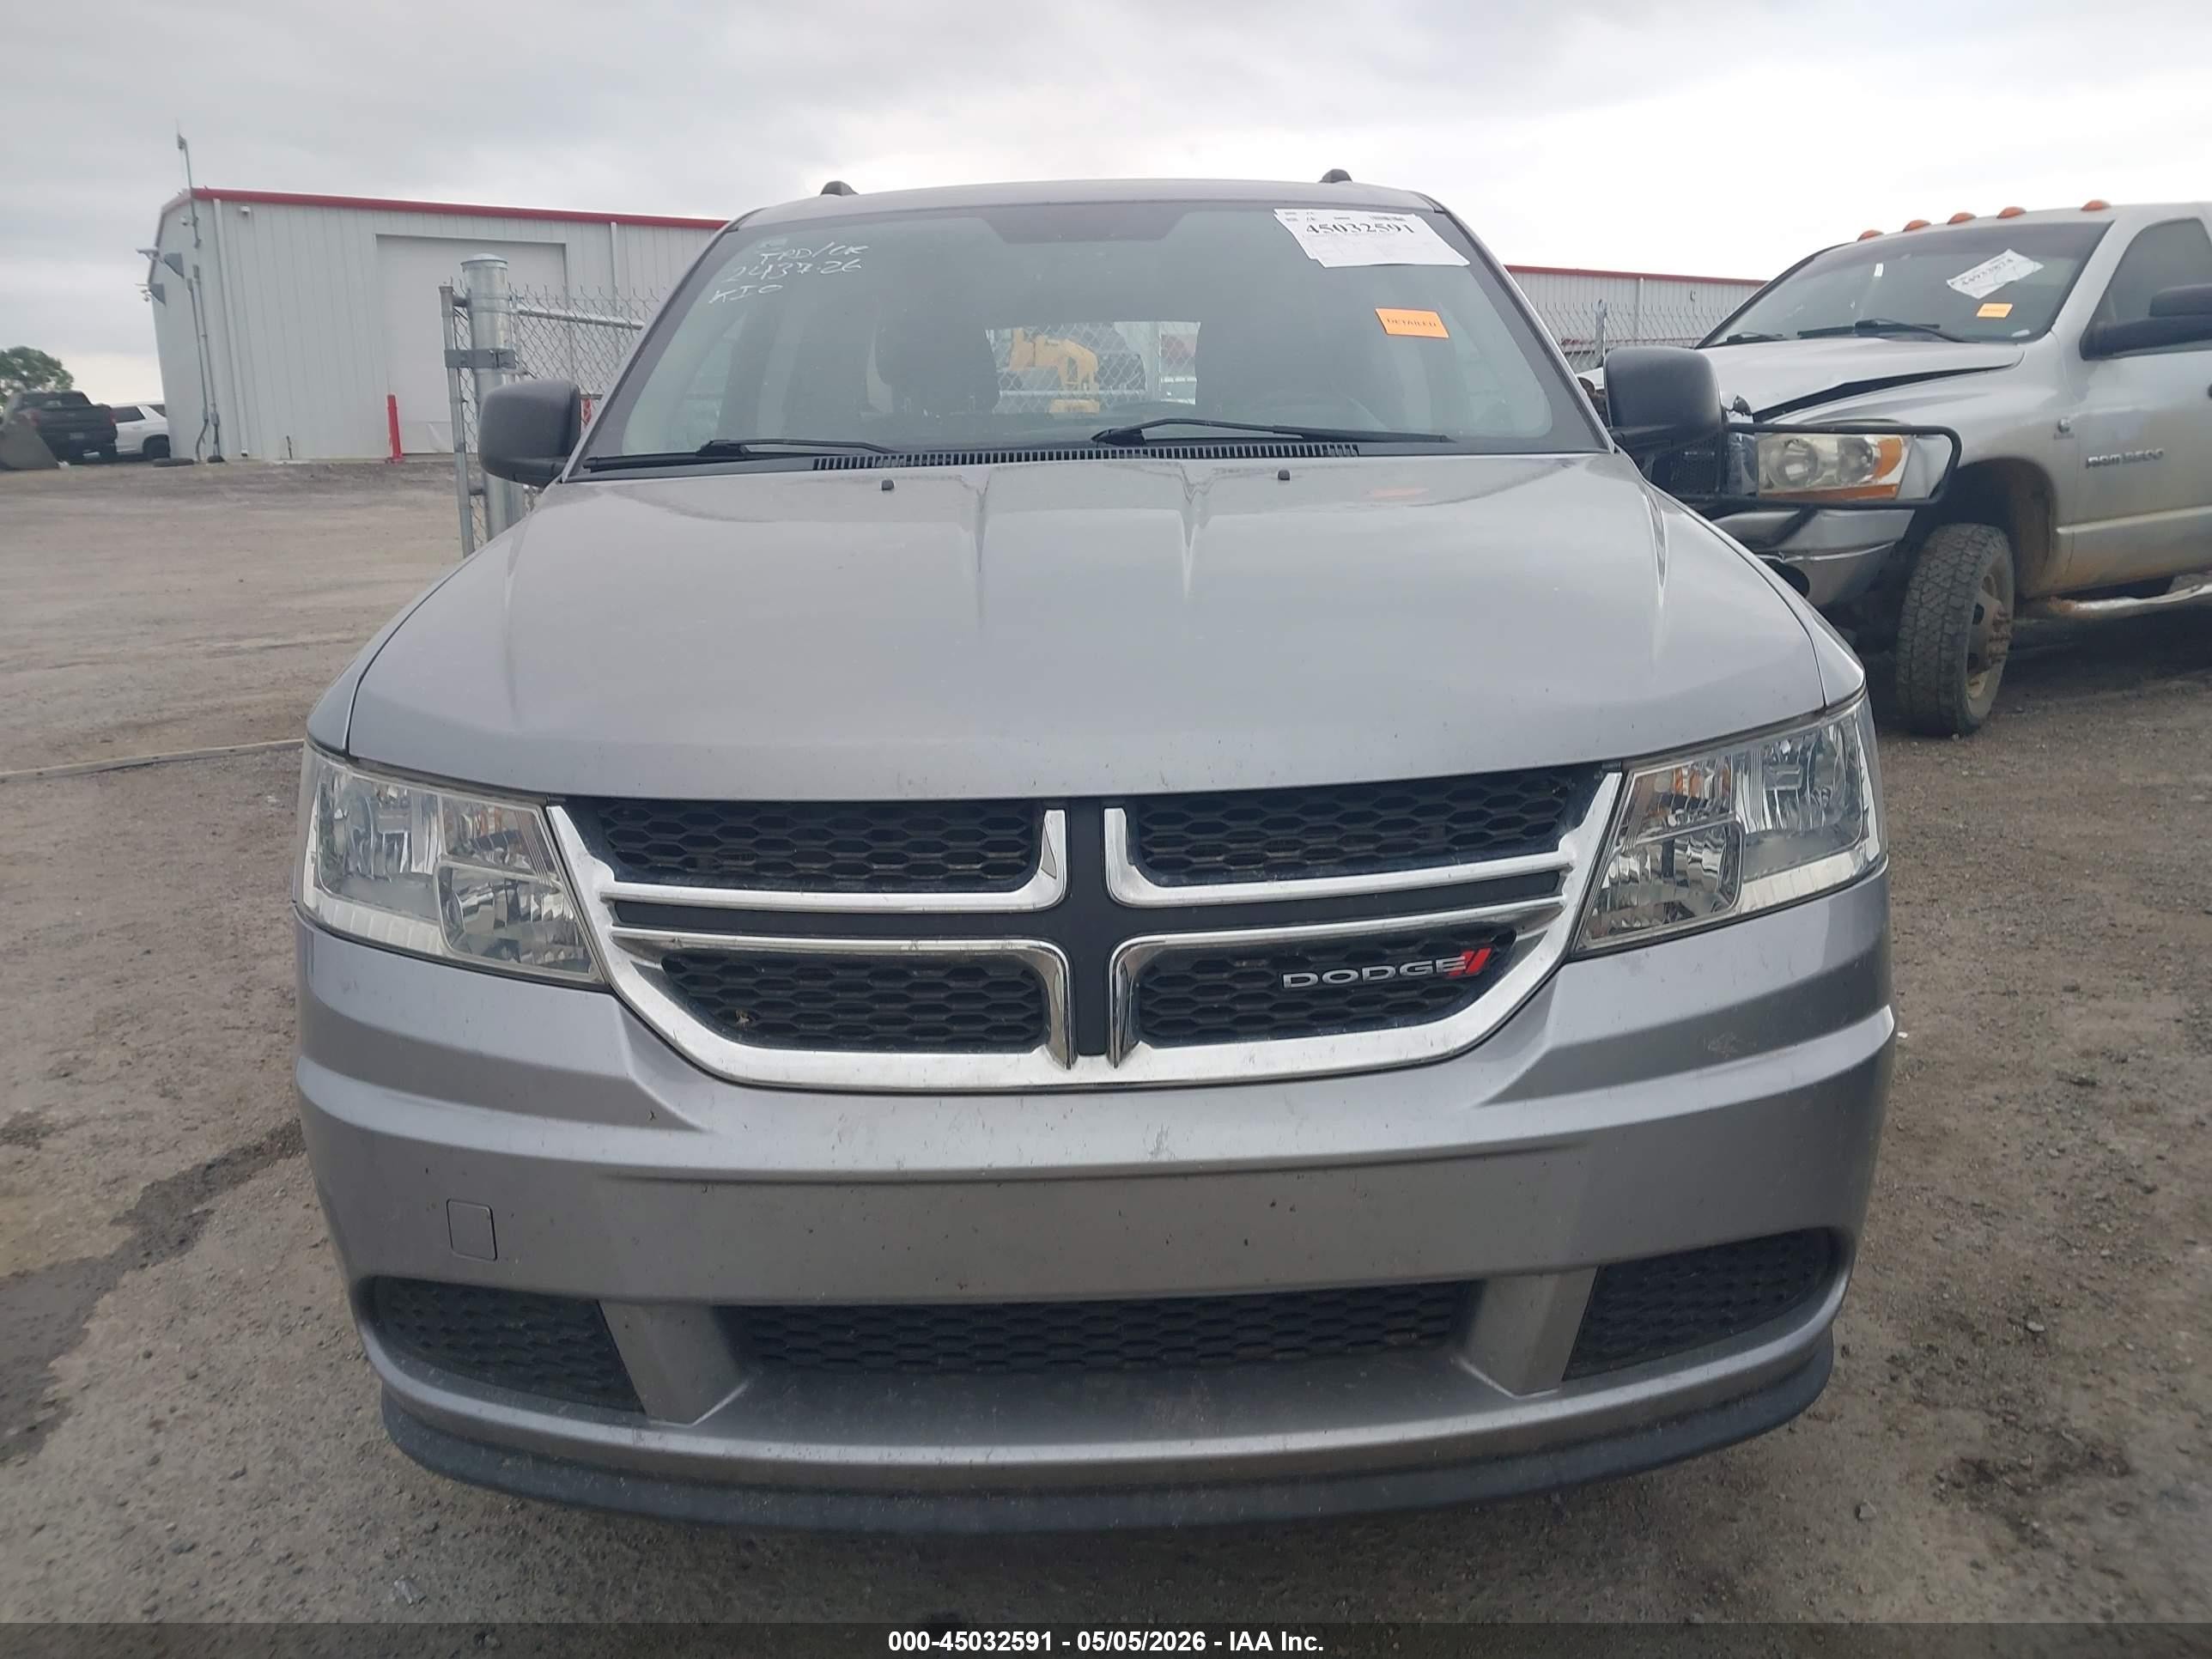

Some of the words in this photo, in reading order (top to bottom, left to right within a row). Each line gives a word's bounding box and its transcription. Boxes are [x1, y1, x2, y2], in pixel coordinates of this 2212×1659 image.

[1306, 222, 1415, 234] 45032591
[1385, 317, 1437, 328] DETAILED
[1282, 956, 1466, 989] DODGE
